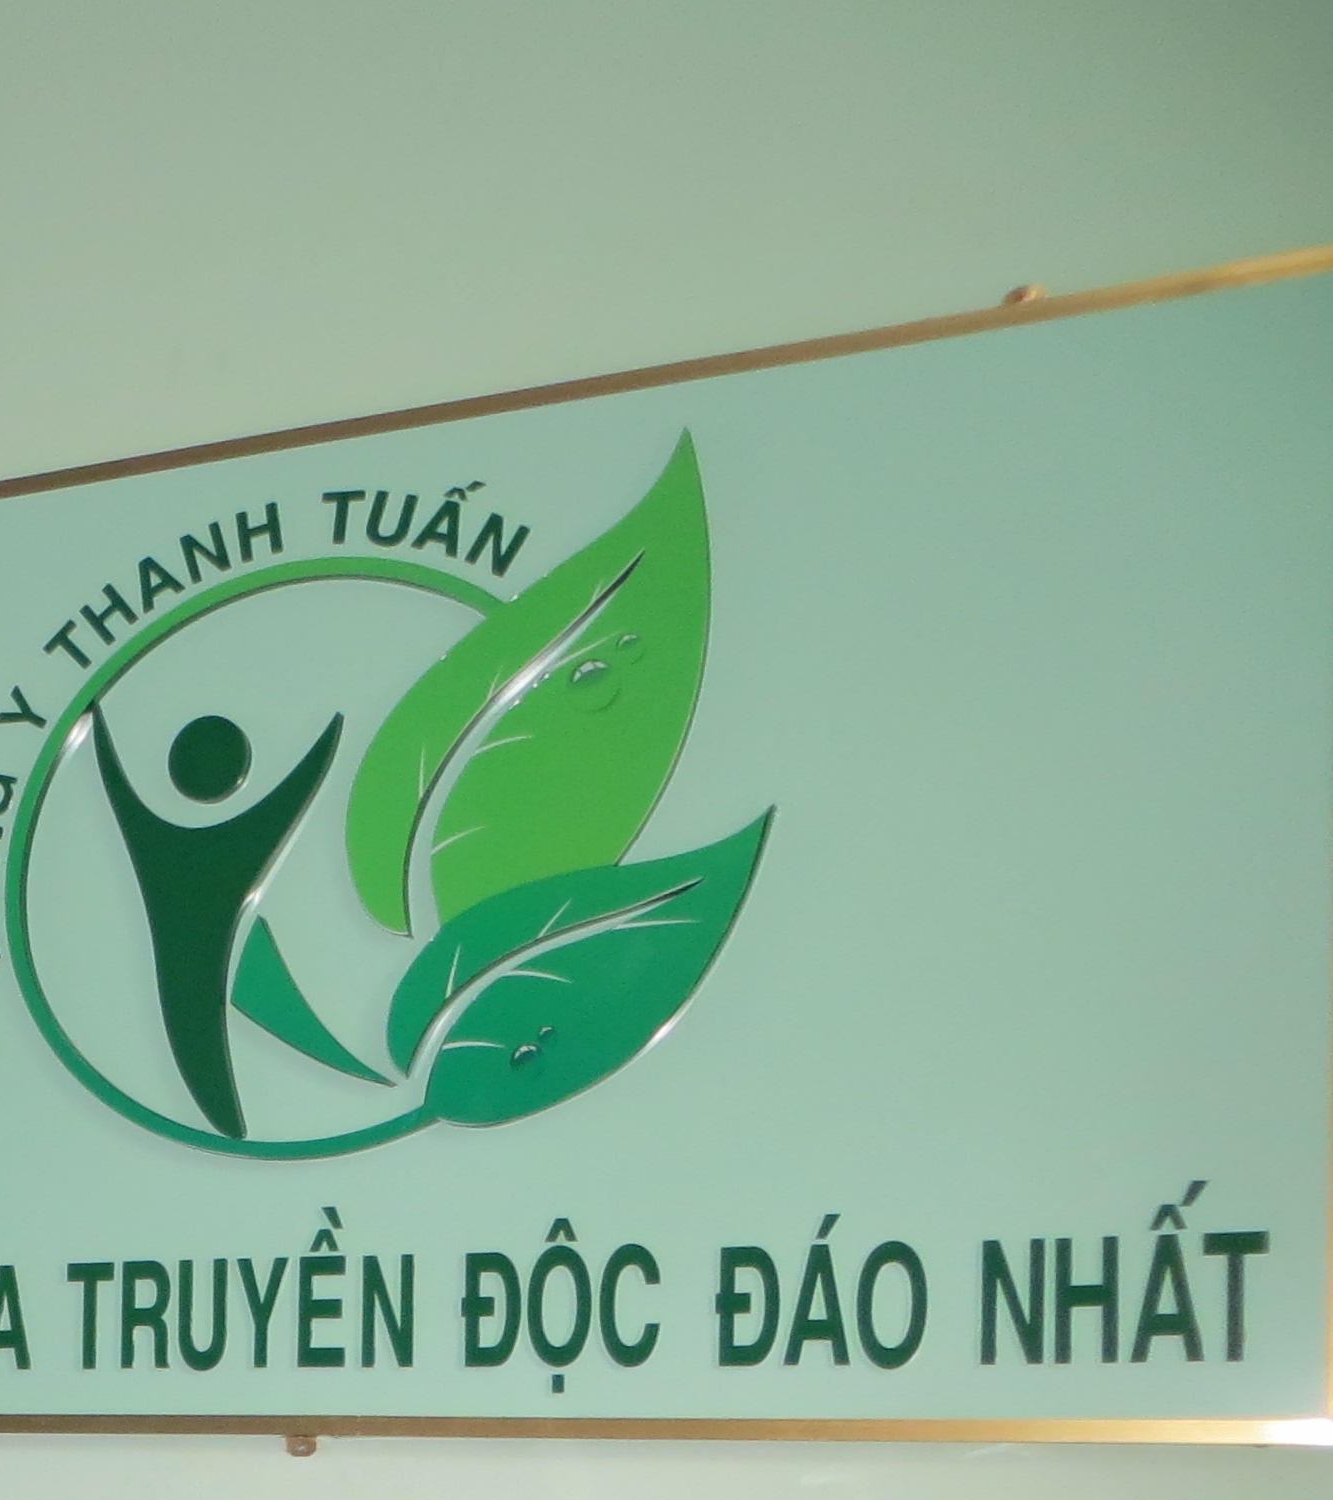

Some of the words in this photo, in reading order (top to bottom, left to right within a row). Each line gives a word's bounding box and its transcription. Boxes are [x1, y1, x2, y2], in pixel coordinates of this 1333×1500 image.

[43, 502, 283, 669] THANH
[322, 480, 530, 578] TUẤN
[66, 1206, 414, 1371] TRUYỀN
[461, 1217, 661, 1393] ĐỘC
[715, 1213, 928, 1369] ĐÁO
[979, 1179, 1271, 1365] NHẤT
